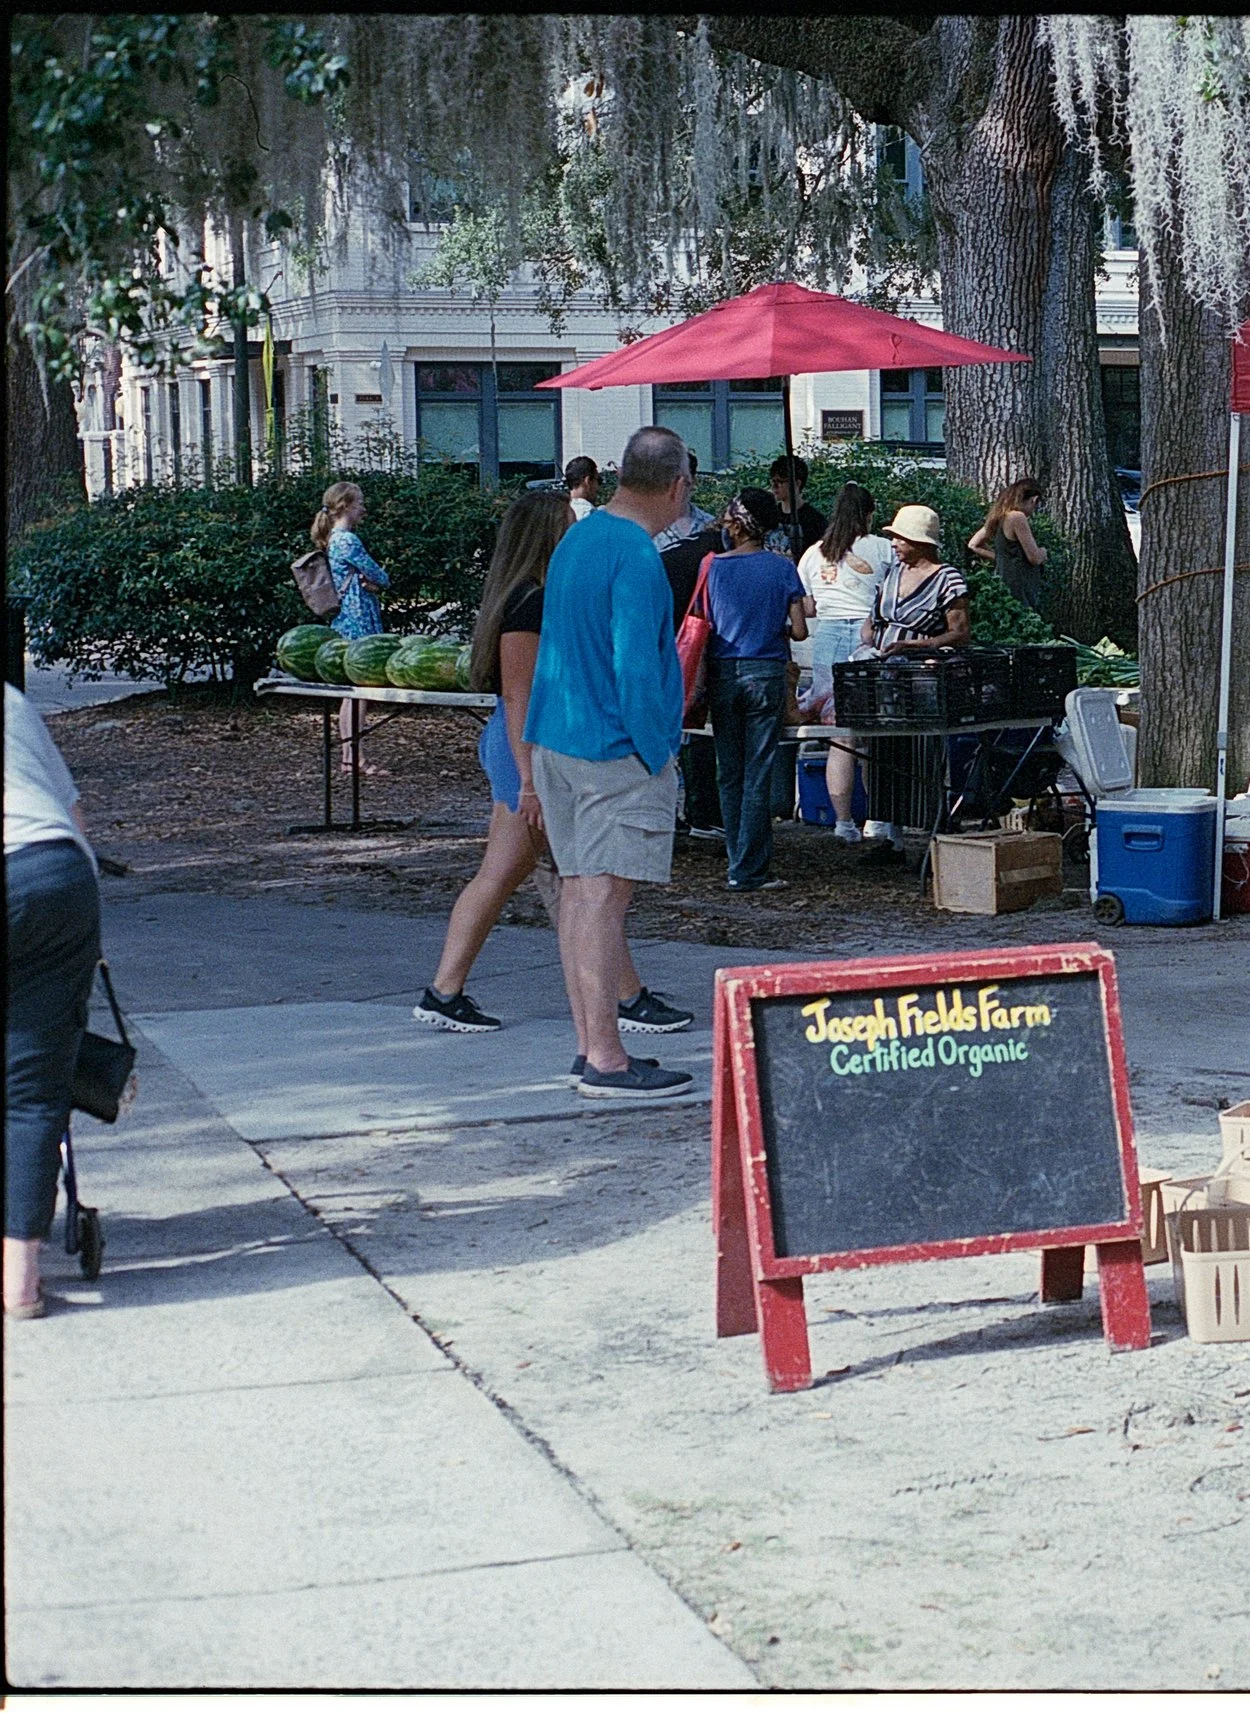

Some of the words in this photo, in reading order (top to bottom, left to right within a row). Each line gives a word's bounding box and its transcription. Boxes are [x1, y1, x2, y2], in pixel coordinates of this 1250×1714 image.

[801, 997, 898, 1052] Joseph
[897, 993, 977, 1038] Fields
[978, 984, 1051, 1033] Farm
[830, 1037, 936, 1076] Certified
[938, 1035, 1029, 1078] Organic
